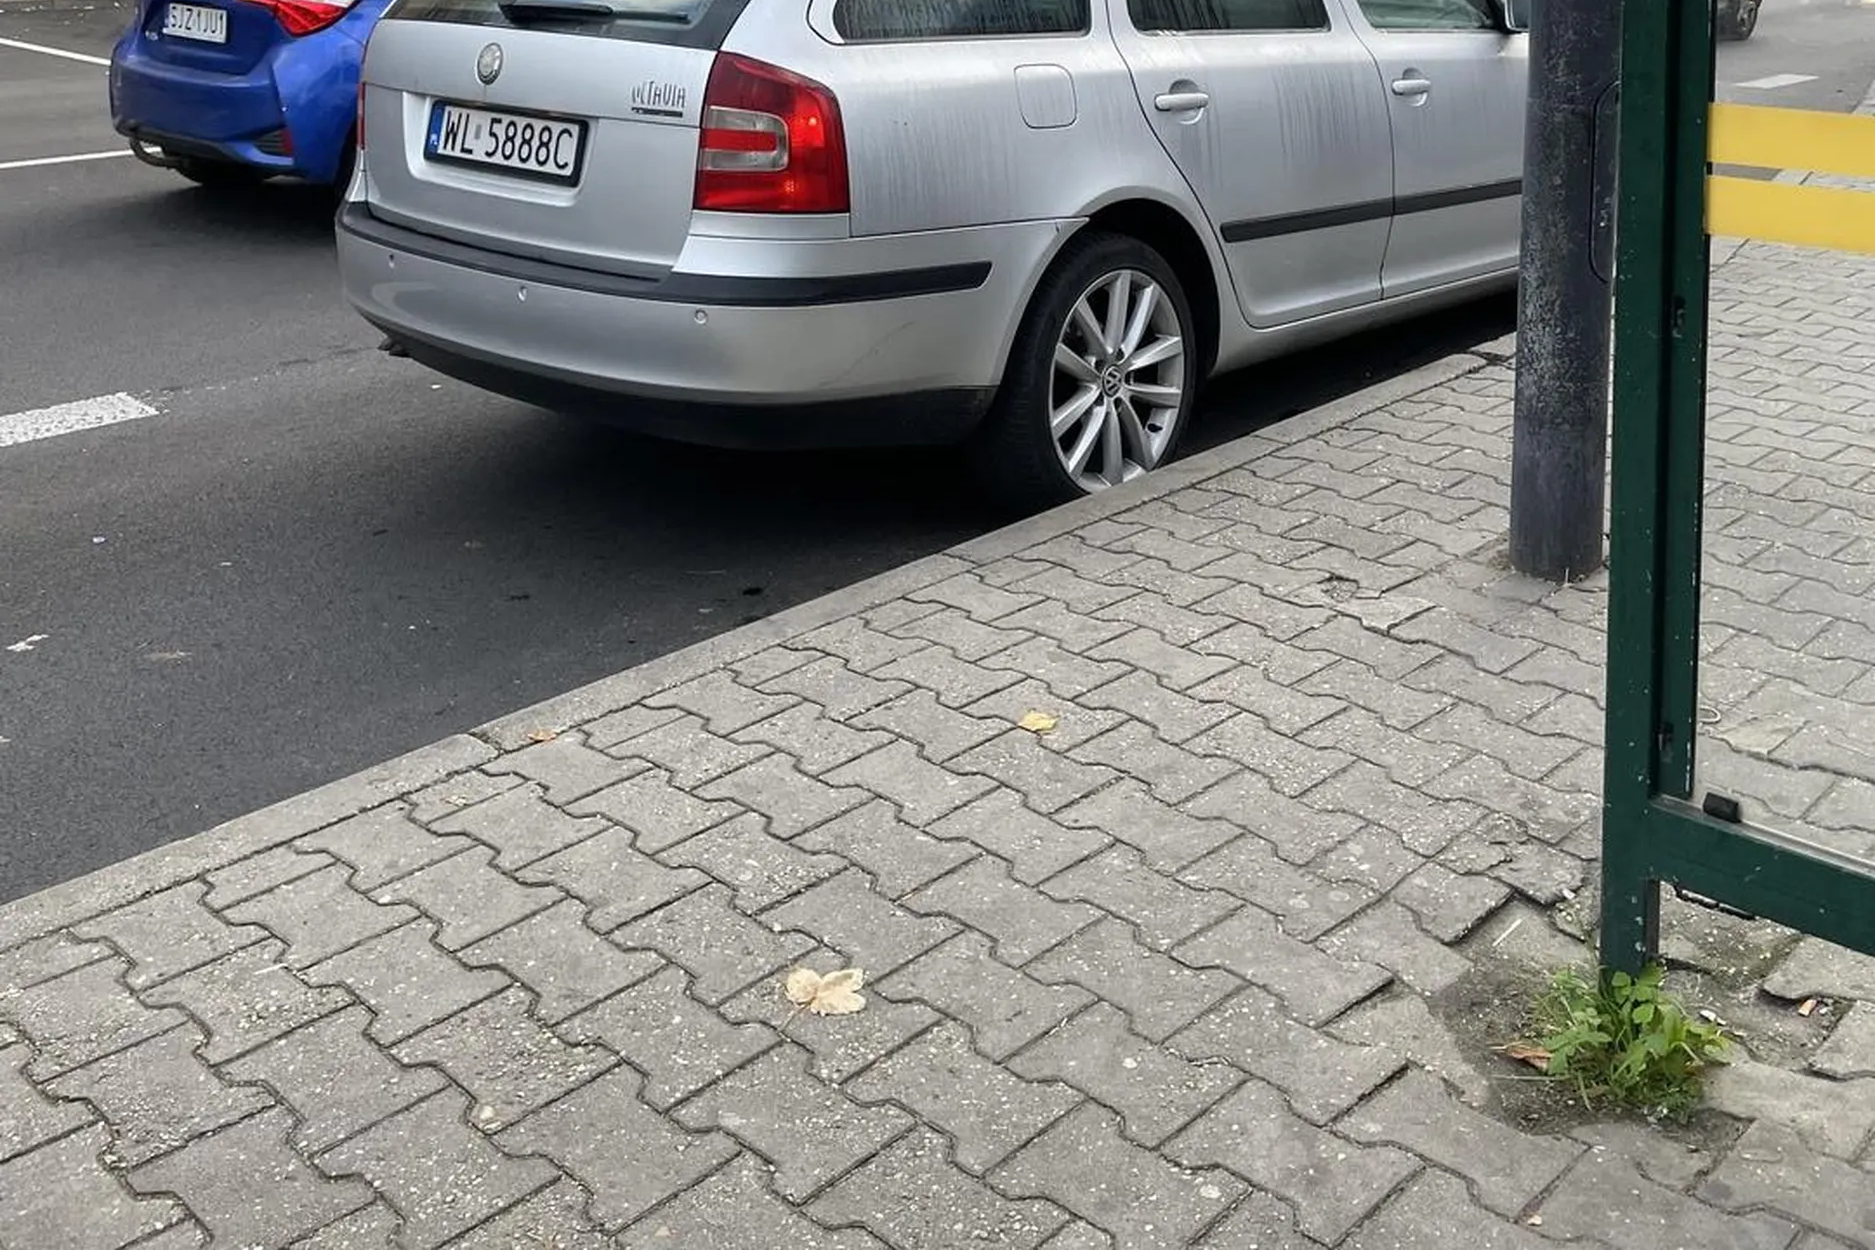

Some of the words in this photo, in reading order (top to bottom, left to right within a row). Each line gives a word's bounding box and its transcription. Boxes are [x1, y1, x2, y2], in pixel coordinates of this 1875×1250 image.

[171, 6, 193, 31] SJZ
[443, 110, 473, 155] WL
[485, 117, 573, 170] 5888C
